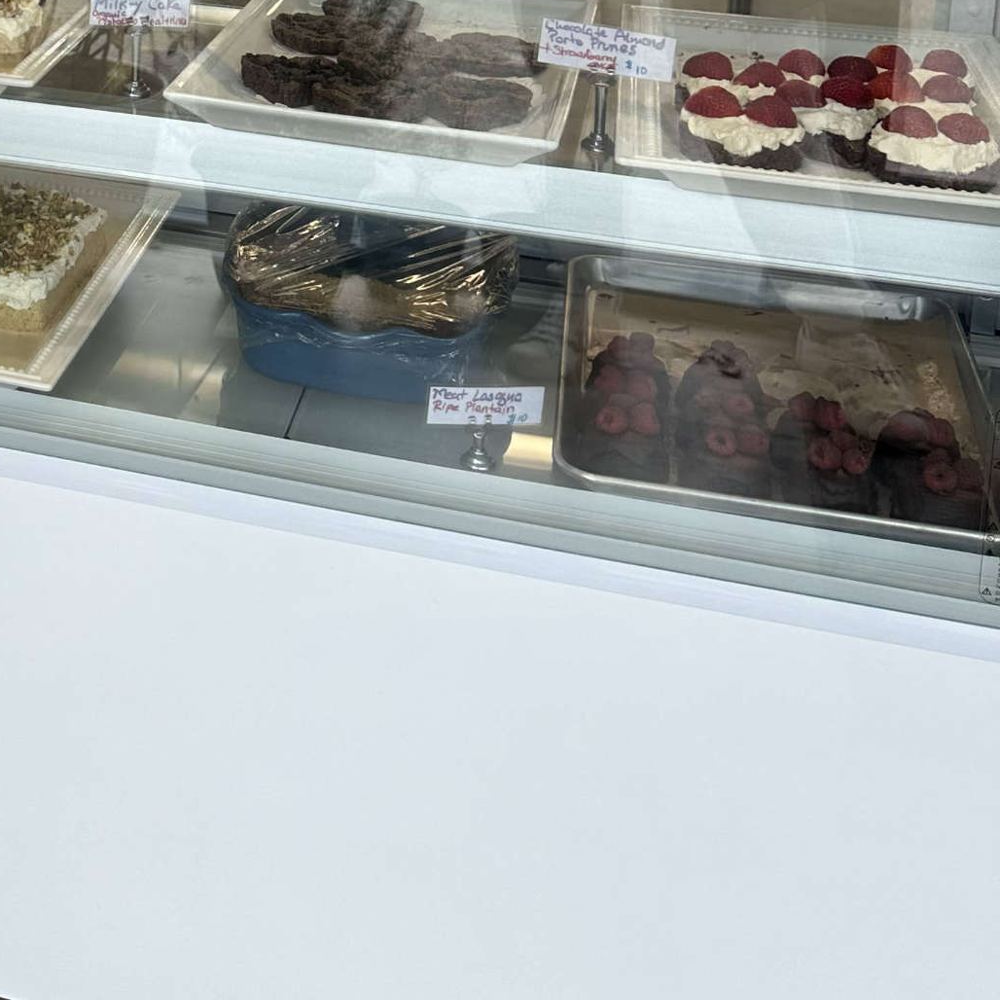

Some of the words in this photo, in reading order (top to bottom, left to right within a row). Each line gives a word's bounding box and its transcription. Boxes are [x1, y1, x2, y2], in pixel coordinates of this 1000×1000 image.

[545, 20, 608, 38] Chocolate
[433, 388, 468, 400] Meat
[433, 400, 459, 414] Ripe
